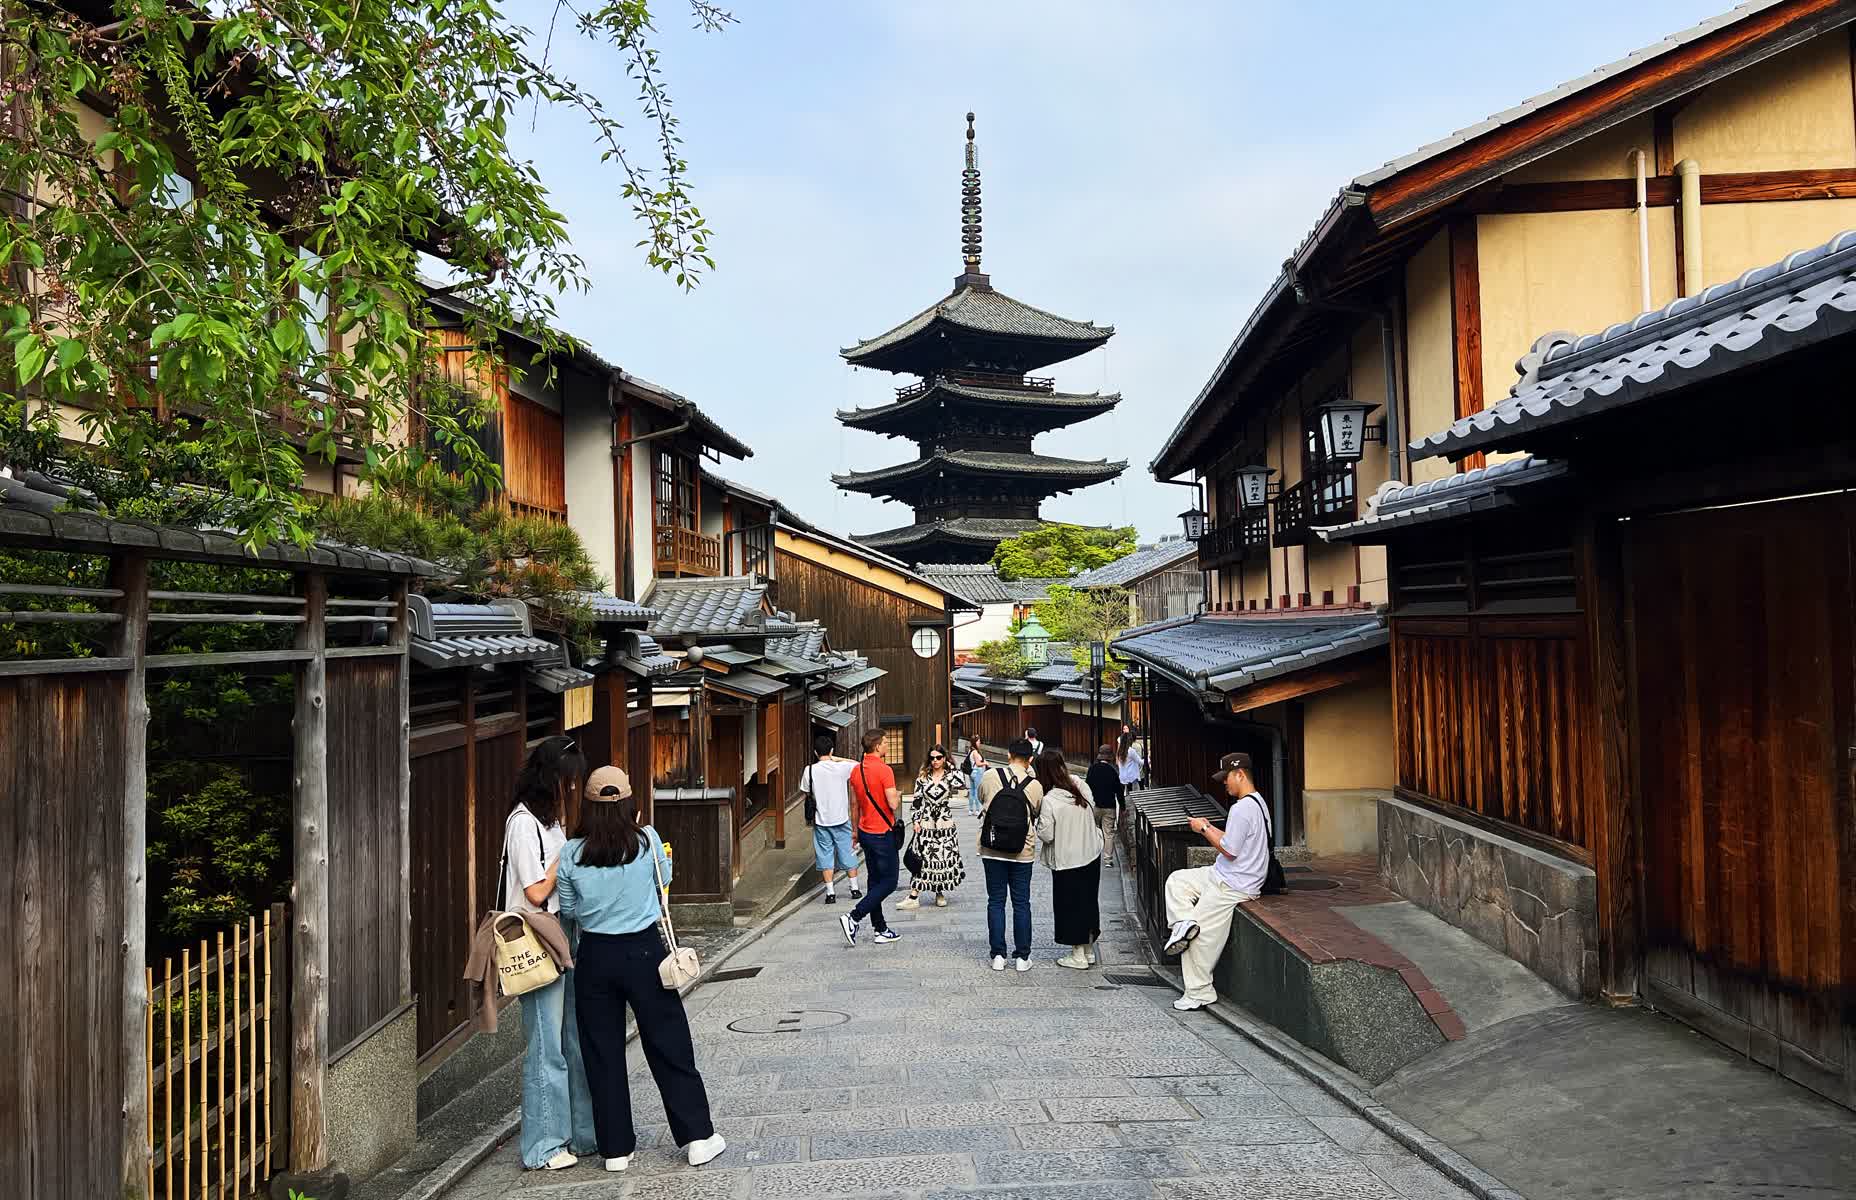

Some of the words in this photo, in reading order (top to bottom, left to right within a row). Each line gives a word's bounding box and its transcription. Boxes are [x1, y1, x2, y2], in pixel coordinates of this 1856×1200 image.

[500, 963, 525, 974] TOTE
[527, 951, 548, 966] BAG
[511, 950, 531, 962] THE
